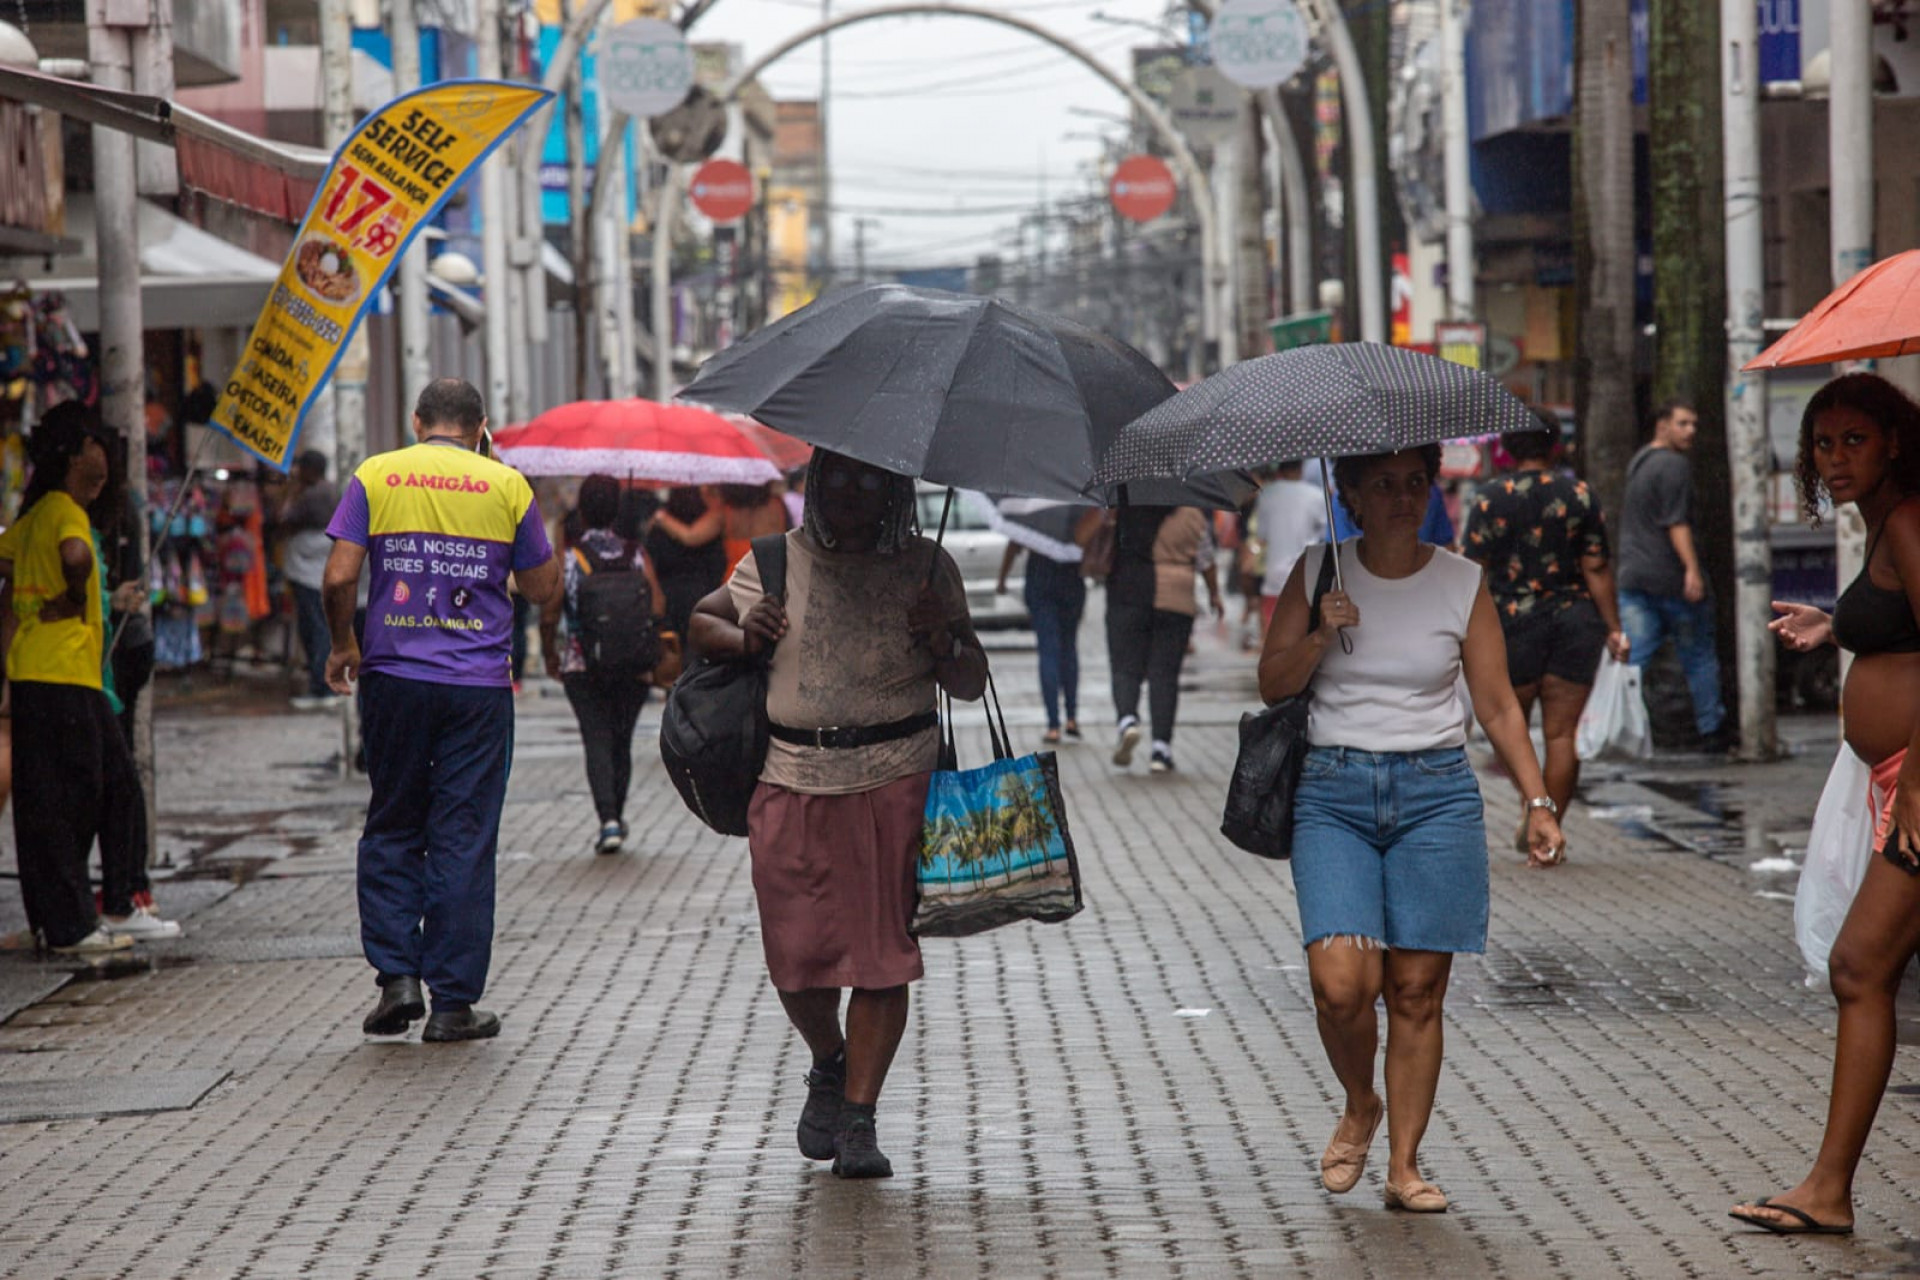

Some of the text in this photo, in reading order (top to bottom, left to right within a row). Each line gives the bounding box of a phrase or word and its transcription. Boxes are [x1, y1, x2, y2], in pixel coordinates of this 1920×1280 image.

[401, 108, 457, 153] SELF
[351, 143, 379, 167] SEM
[364, 118, 455, 189] SERVICE
[226, 381, 281, 424] GSTOSA
[386, 472, 490, 494] O AMIGÃO
[384, 538, 487, 559] SIGA NOSSAS
[431, 560, 488, 579] SOCIAIS
